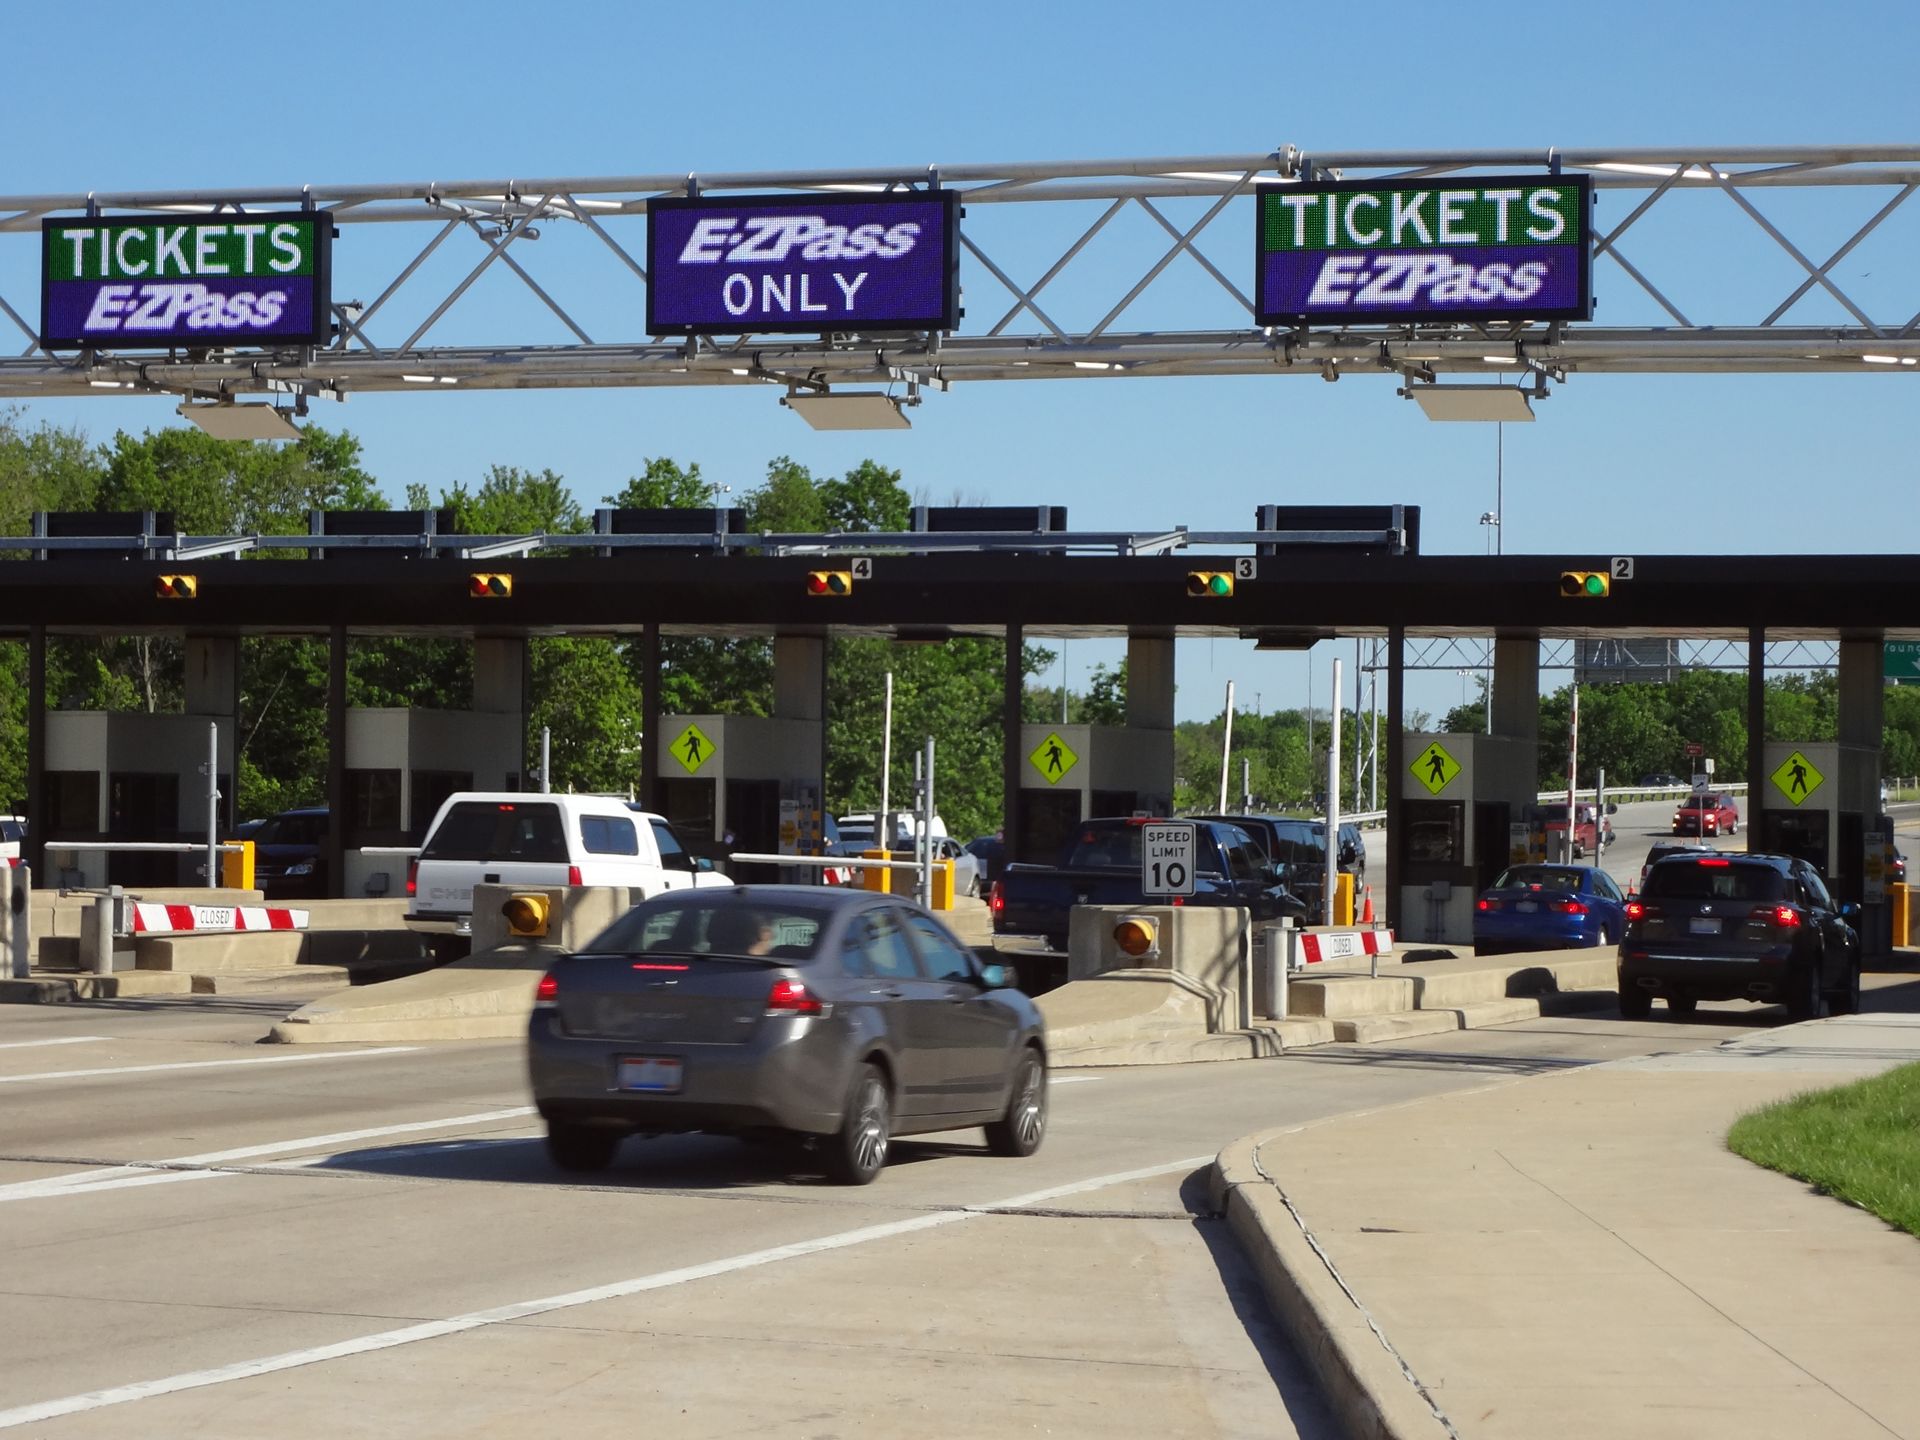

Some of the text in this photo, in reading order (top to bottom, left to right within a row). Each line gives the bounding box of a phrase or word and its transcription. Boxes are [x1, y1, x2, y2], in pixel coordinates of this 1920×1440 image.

[1281, 189, 1566, 247] TICKETS
[63, 224, 302, 277] TICKETS
[723, 272, 869, 316] ONLY
[855, 559, 869, 577] 4
[1239, 559, 1253, 578] 3
[1615, 559, 1630, 578] 2
[1148, 832, 1190, 842] SPEED
[1152, 847, 1186, 857] LIMIT
[1152, 862, 1186, 888] 10
[200, 910, 230, 924] CLOSED
[1333, 937, 1352, 953] CLOSED
